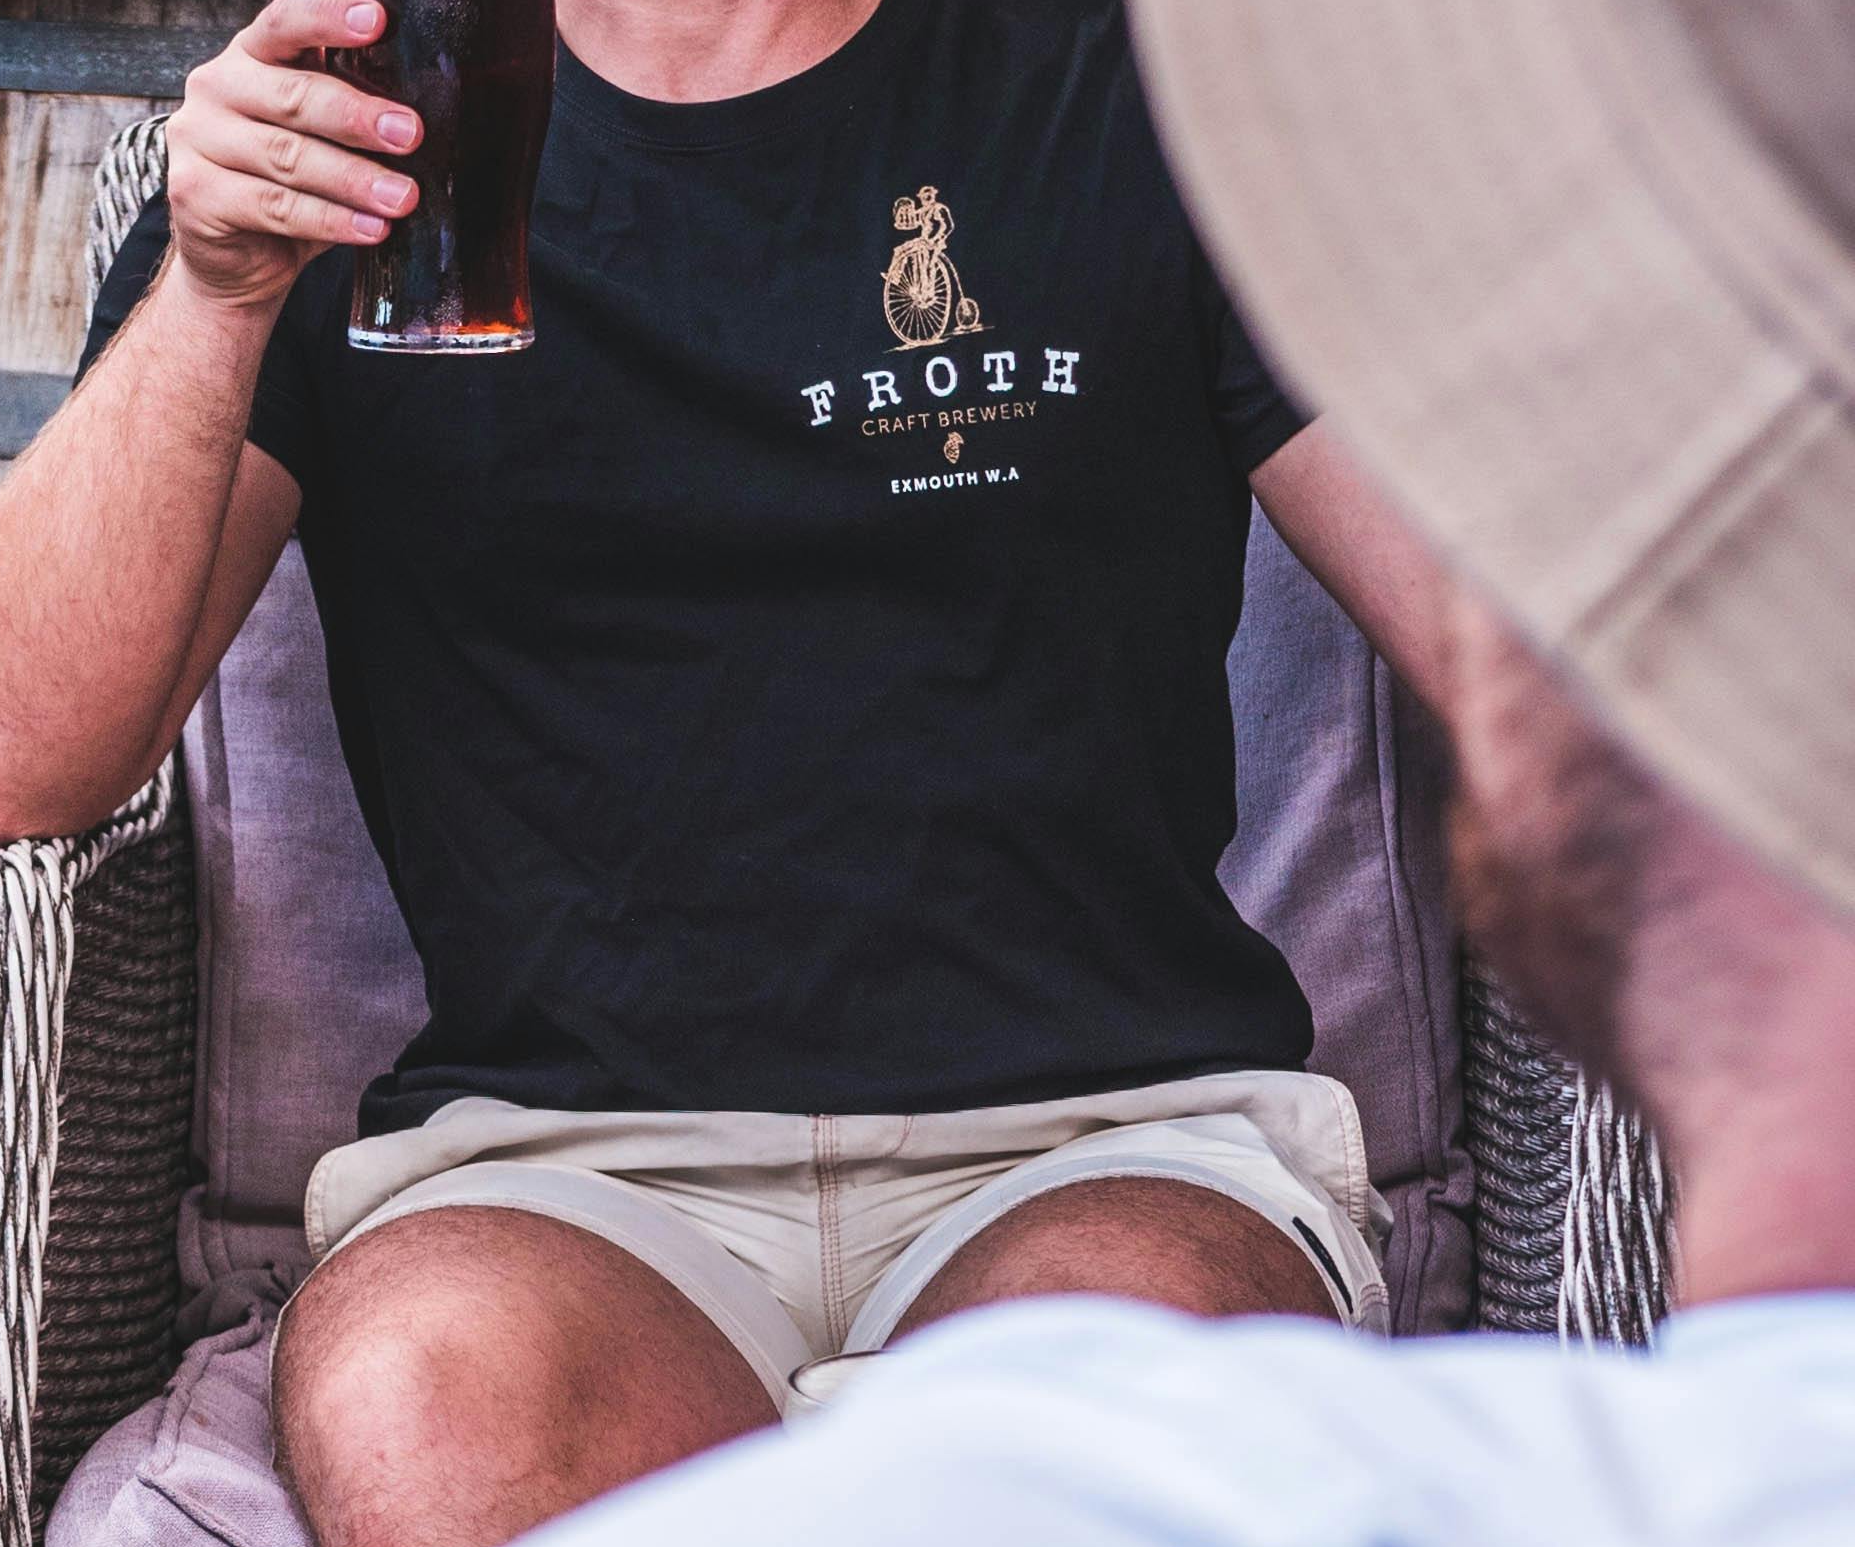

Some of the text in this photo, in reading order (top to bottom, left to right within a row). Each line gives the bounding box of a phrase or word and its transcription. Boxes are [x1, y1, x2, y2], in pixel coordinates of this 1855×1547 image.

[800, 347, 1080, 427] FROTH
[861, 401, 1037, 436] CRAFT BREWERY
[890, 467, 1019, 494] EXMOUTH W.A
